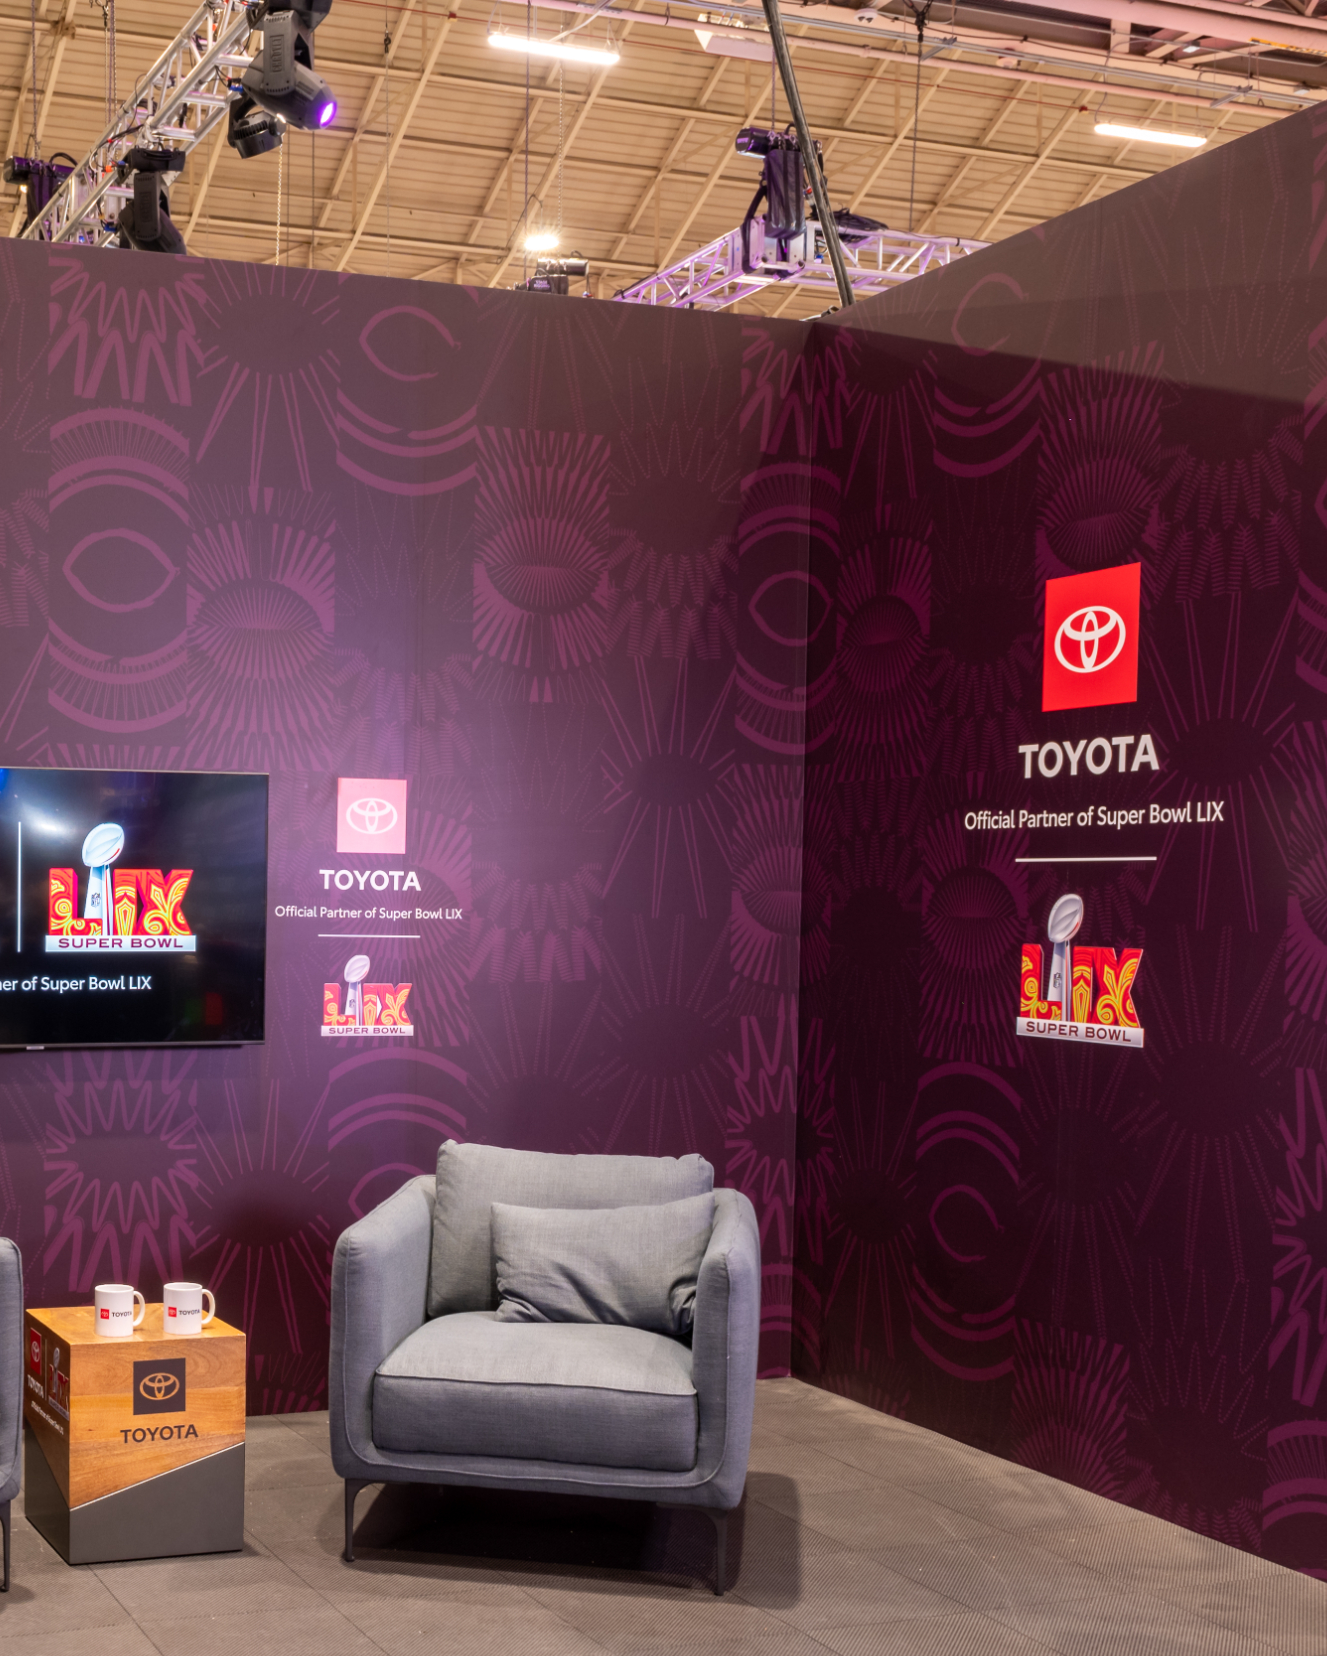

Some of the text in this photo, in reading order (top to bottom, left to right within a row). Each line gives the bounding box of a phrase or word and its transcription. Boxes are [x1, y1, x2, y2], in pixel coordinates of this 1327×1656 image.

[1018, 733, 1160, 779] TOYOTA
[964, 800, 1225, 831] Official Partner of Super Bowl LIX
[318, 868, 422, 892] TOYOTA
[48, 867, 194, 936] LIX
[274, 905, 463, 922] Official Partner of Super Bowl LIX
[58, 937, 184, 949] SUPER BOWL
[20, 975, 39, 991] of
[40, 976, 86, 994] Super
[88, 975, 126, 991] Bowl
[128, 975, 152, 990] LIX
[1020, 943, 1144, 1029] LIX
[323, 983, 413, 1026] LIX
[328, 1027, 406, 1035] SUPER BOWL
[1025, 1020, 1132, 1043] SUPER BOWL
[178, 1308, 201, 1316] TOYOTA
[119, 1423, 199, 1444] TOYOTA
